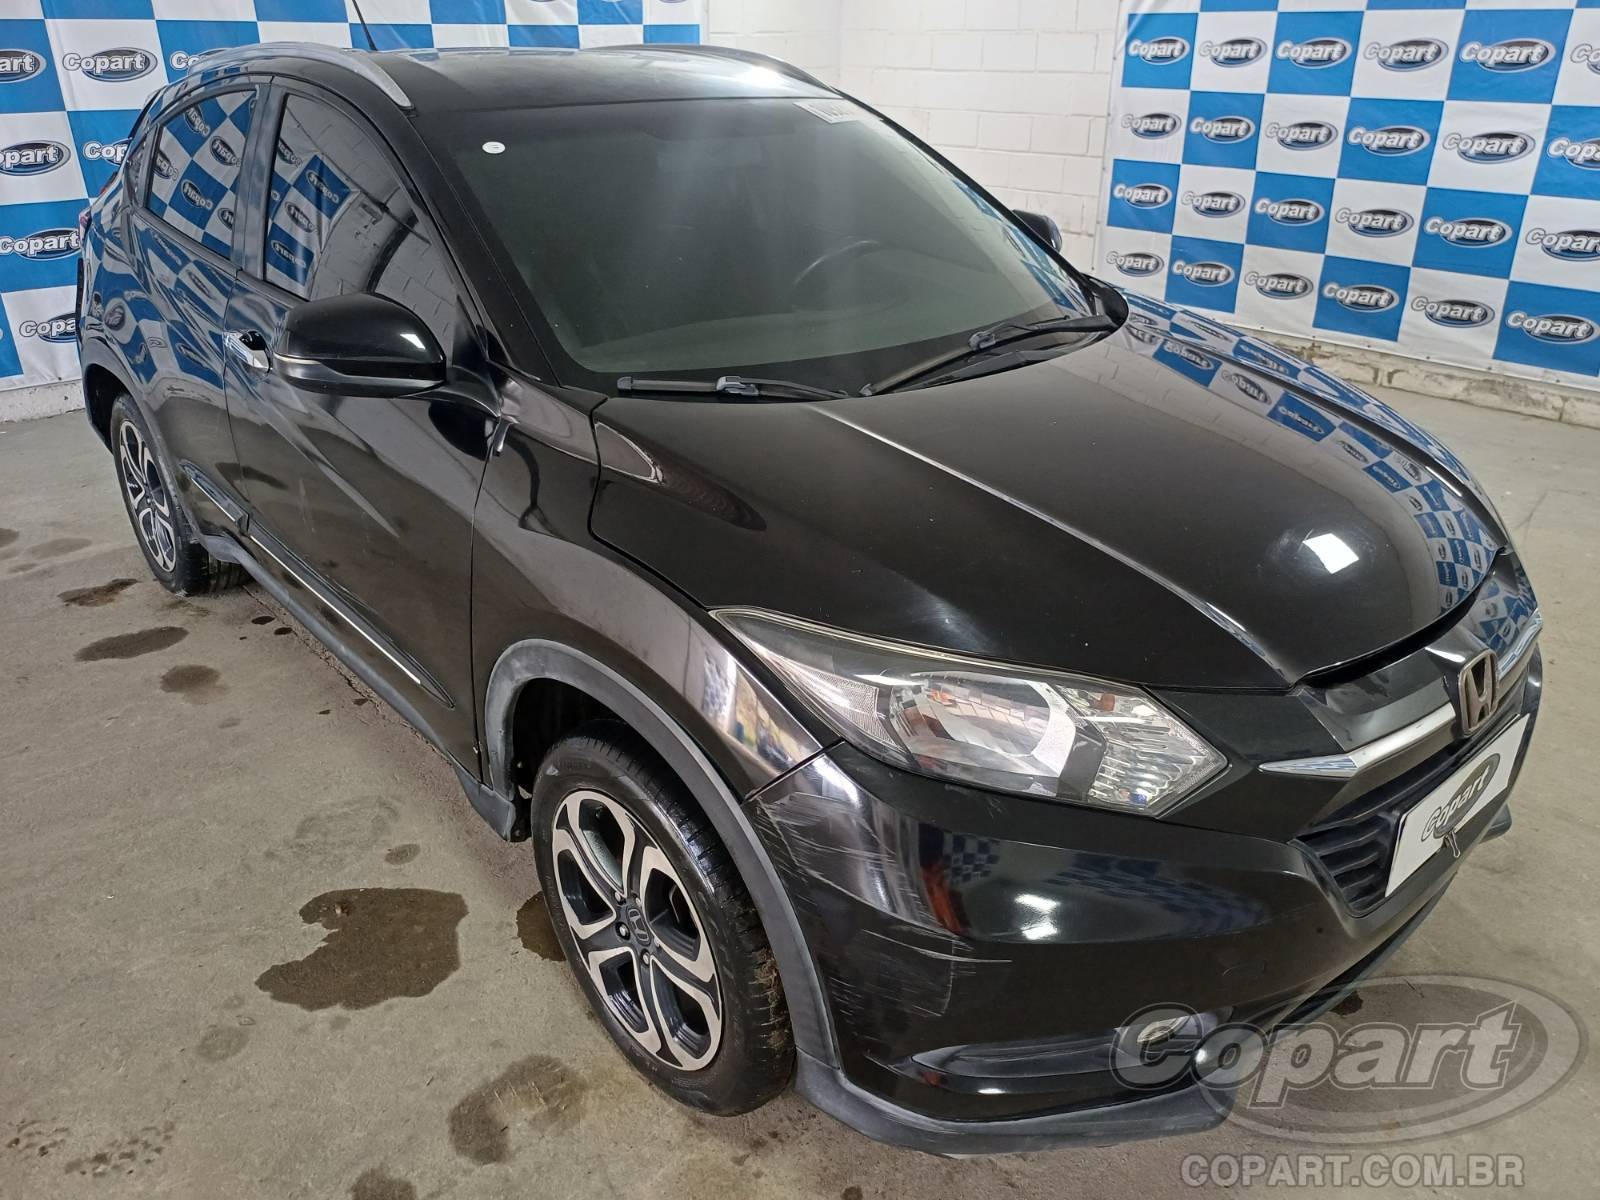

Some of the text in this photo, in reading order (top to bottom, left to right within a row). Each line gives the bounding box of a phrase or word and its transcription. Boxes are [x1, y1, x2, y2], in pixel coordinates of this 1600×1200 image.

[1128, 39, 1182, 60] Copart
[1199, 41, 1258, 61] Copart
[1277, 41, 1341, 63] Copart
[1364, 42, 1438, 64] Copart
[1459, 41, 1543, 68] Copart
[62, 52, 147, 76] Copart
[1121, 114, 1174, 136] Copart
[1190, 117, 1248, 139] Copart
[1265, 122, 1328, 144] Copart
[1348, 126, 1422, 151] Copart
[1442, 132, 1525, 156] Copart
[1113, 183, 1166, 204] Copart
[1181, 190, 1238, 212] Copart
[1254, 198, 1319, 220] Copart
[1335, 207, 1404, 231] Copart
[1424, 216, 1504, 243] Copart
[1525, 228, 1600, 253] Copar
[0, 230, 80, 257] Copart
[1106, 251, 1157, 272] Copart
[1172, 260, 1229, 283] Copart
[1244, 271, 1306, 293] Copart
[1322, 282, 1393, 308] Copart
[1411, 296, 1487, 323] Copart
[1506, 310, 1592, 339] Copart
[1421, 764, 1490, 841] Copart
